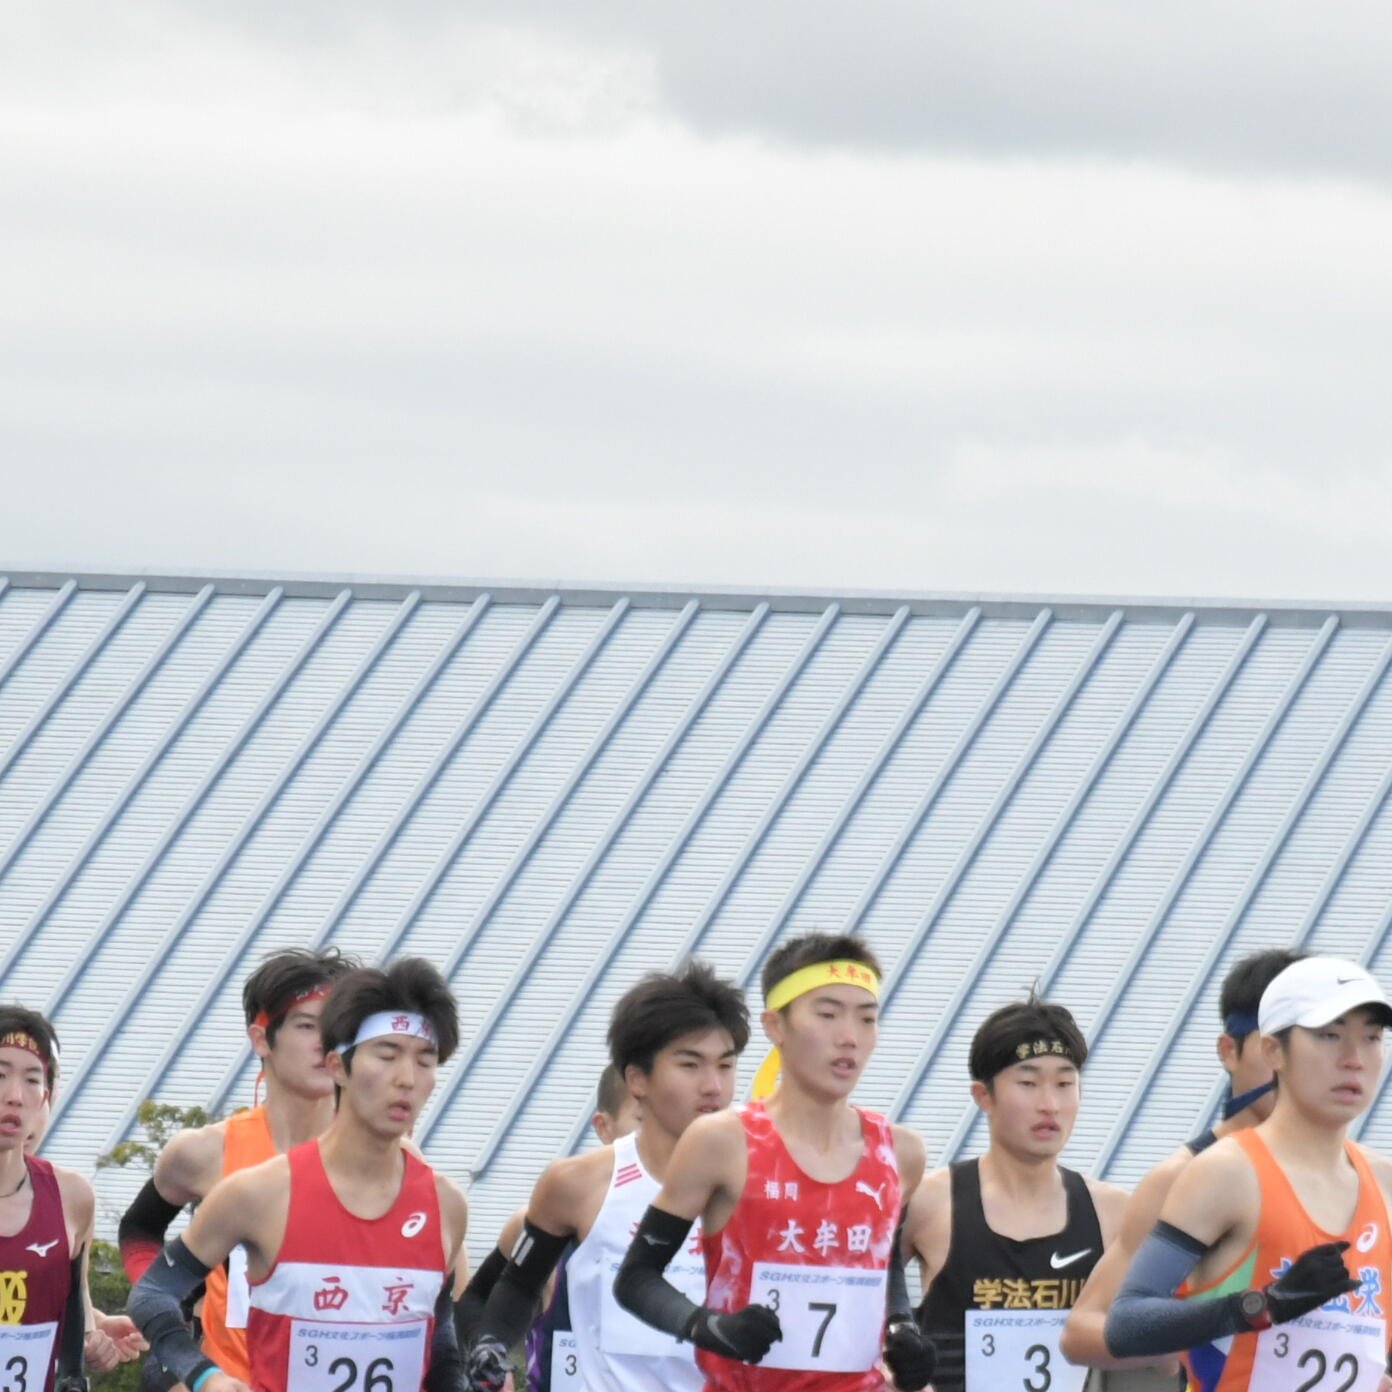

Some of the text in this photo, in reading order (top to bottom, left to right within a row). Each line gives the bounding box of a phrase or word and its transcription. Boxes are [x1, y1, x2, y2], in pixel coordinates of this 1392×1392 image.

[764, 1180, 799, 1201] 福岡
[776, 1219, 872, 1257] 大牟田
[313, 1276, 415, 1316] 西京
[766, 1288, 781, 1312] 3
[973, 1278, 1086, 1310] 学法石川
[808, 1302, 837, 1358] 7
[304, 1345, 318, 1367] 3
[982, 1334, 996, 1357] 3
[1273, 1333, 1289, 1358] 3
[565, 1355, 577, 1376] 3
